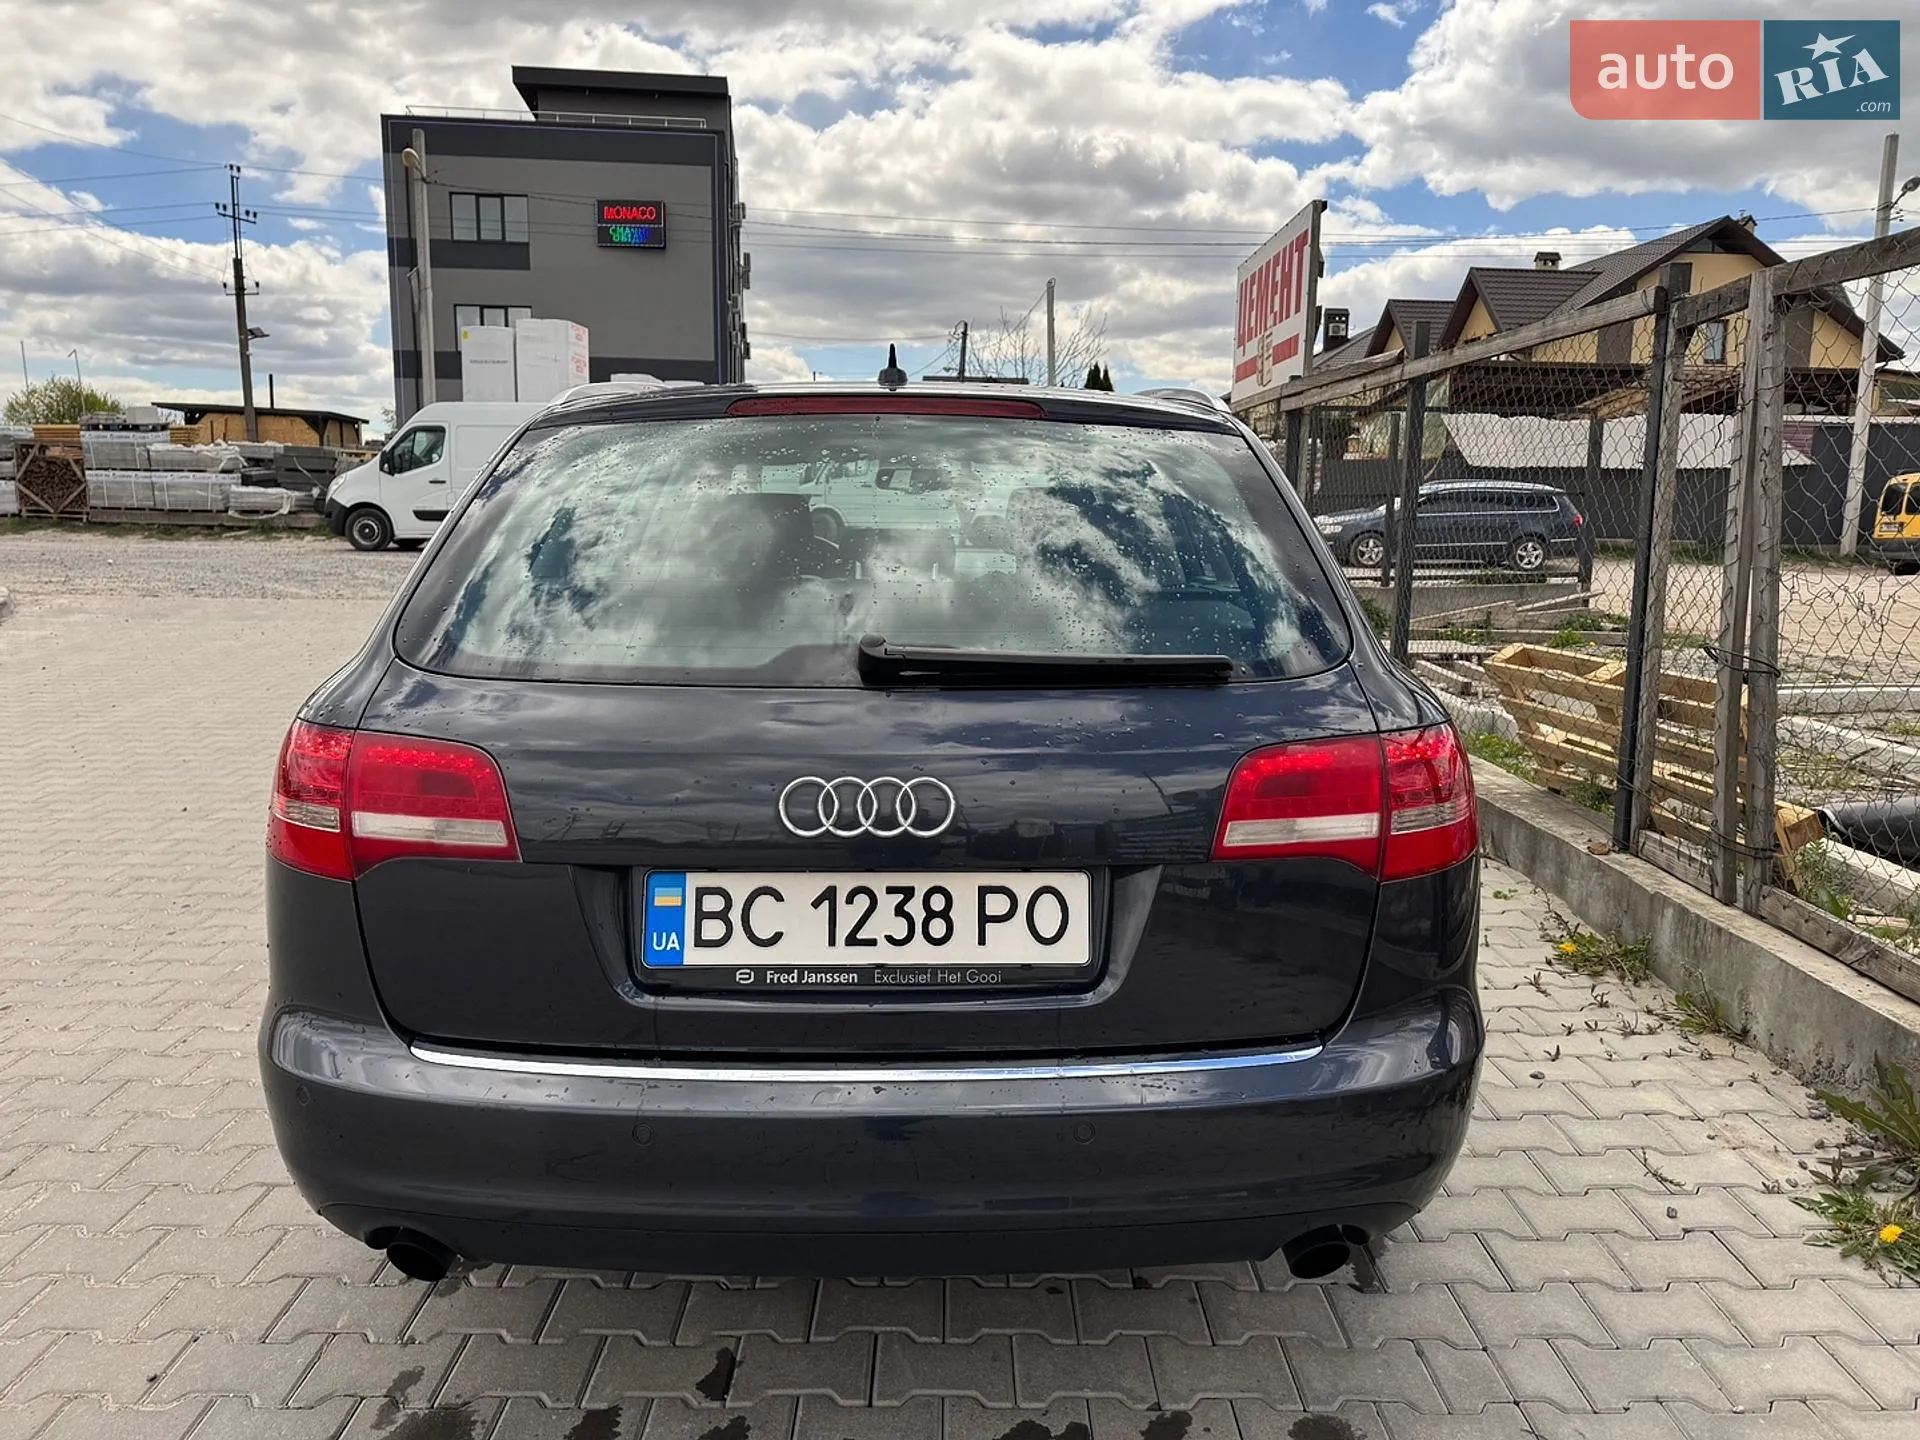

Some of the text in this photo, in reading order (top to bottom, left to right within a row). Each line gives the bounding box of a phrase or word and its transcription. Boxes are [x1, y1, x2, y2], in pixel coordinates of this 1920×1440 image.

[603, 206, 656, 220] MONACO
[1237, 228, 1309, 356] ЦЕМЕНТ
[693, 884, 1070, 948] BC 1238 PO
[652, 932, 680, 951] UA
[766, 969, 1002, 984] Fred Janssen Exclusief Het Gooi
